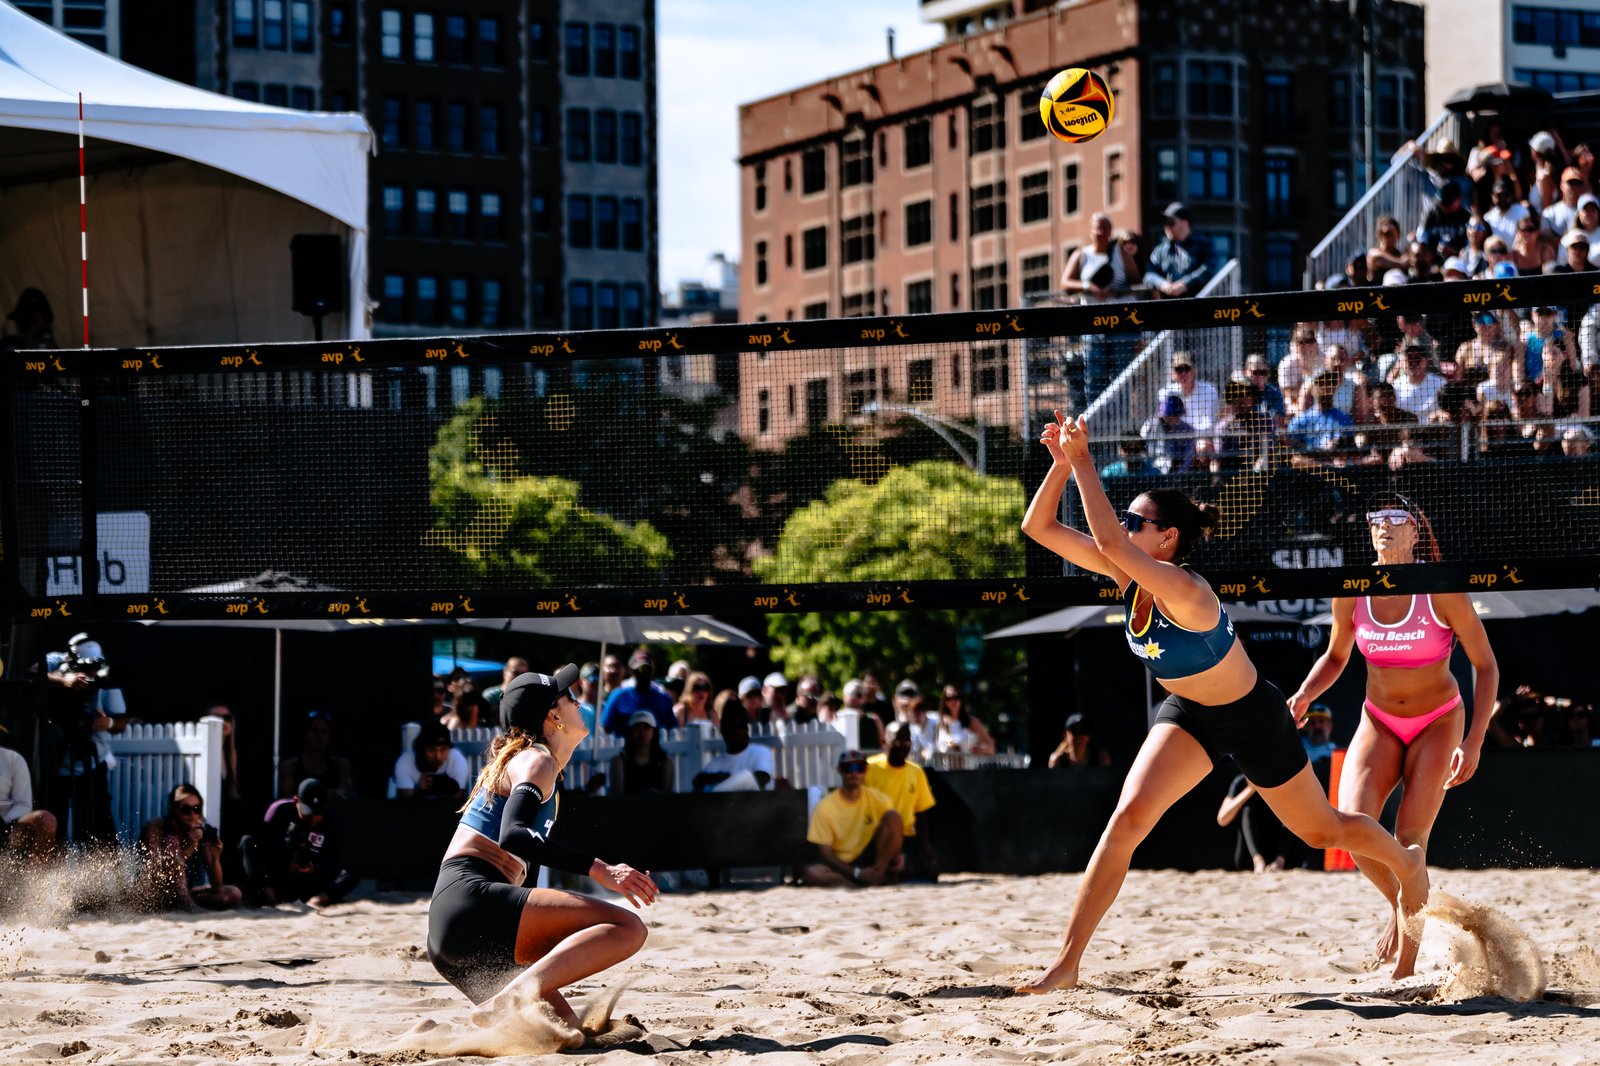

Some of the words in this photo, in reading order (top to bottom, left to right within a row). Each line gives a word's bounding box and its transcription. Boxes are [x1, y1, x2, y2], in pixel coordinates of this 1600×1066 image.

[1064, 112, 1098, 127] Wilson
[1463, 291, 1491, 305] avp
[1337, 299, 1364, 313] avp
[1093, 314, 1119, 327] avp
[1214, 307, 1240, 321] avp
[862, 327, 886, 340] avp
[976, 321, 1001, 334] avp
[639, 338, 662, 352] avp
[749, 333, 772, 346] avp
[426, 347, 448, 360] avp
[531, 343, 554, 356] avp
[221, 354, 242, 367] avp
[322, 351, 343, 364] avp
[24, 360, 45, 373] avp
[122, 358, 142, 371] avp
[1343, 578, 1370, 592] avp
[1470, 572, 1497, 586] avp
[1220, 583, 1246, 596] avp
[754, 596, 778, 608] avp
[866, 593, 890, 605] avp
[981, 590, 1006, 603] avp
[126, 604, 149, 616] avp
[226, 604, 248, 615] avp
[328, 603, 350, 615] avp
[431, 602, 453, 615] avp
[536, 601, 559, 613] avp
[644, 599, 667, 611] avp
[31, 607, 53, 619] avp
[1357, 627, 1385, 641] Palm
[1386, 629, 1425, 641] Beach
[1367, 643, 1412, 654] Passion
